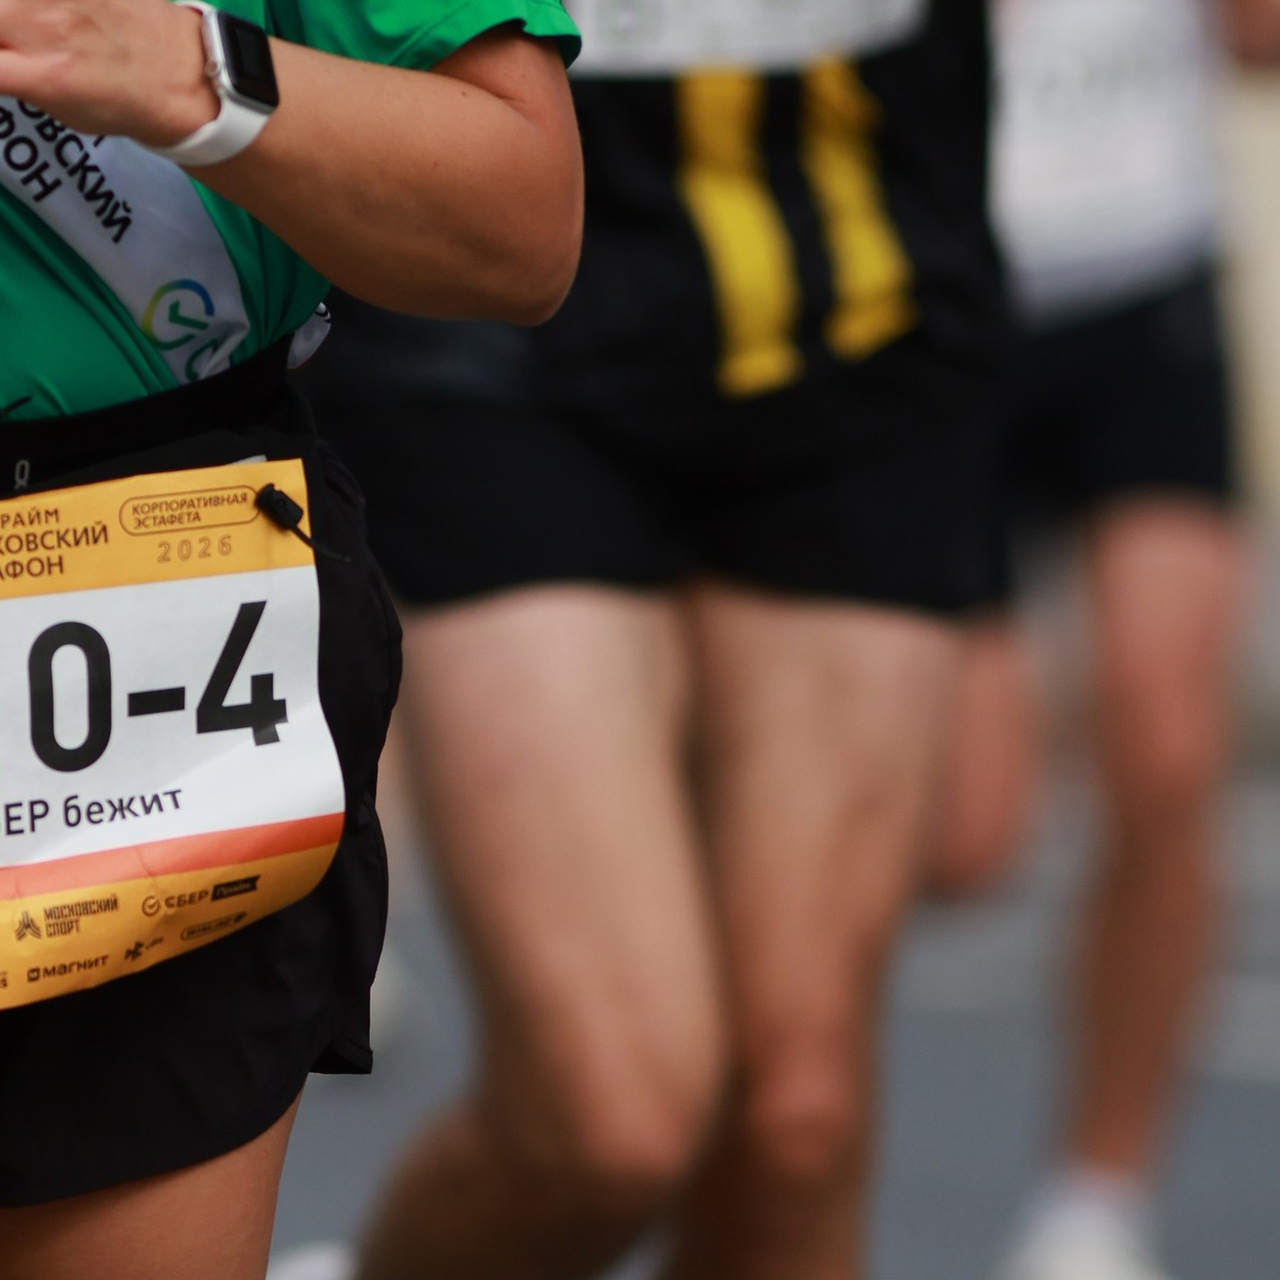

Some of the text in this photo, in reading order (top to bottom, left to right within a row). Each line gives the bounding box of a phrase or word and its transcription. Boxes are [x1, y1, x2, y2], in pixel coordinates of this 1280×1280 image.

[132, 492, 248, 516] КОРПОРАТИВНАЯ
[133, 510, 201, 531] ЭСТАФЕТА
[157, 534, 233, 564] 2026
[63, 789, 183, 828] бежит
[43, 893, 118, 920] МОСКОВСКИЙ
[46, 918, 81, 938] СПОРТ
